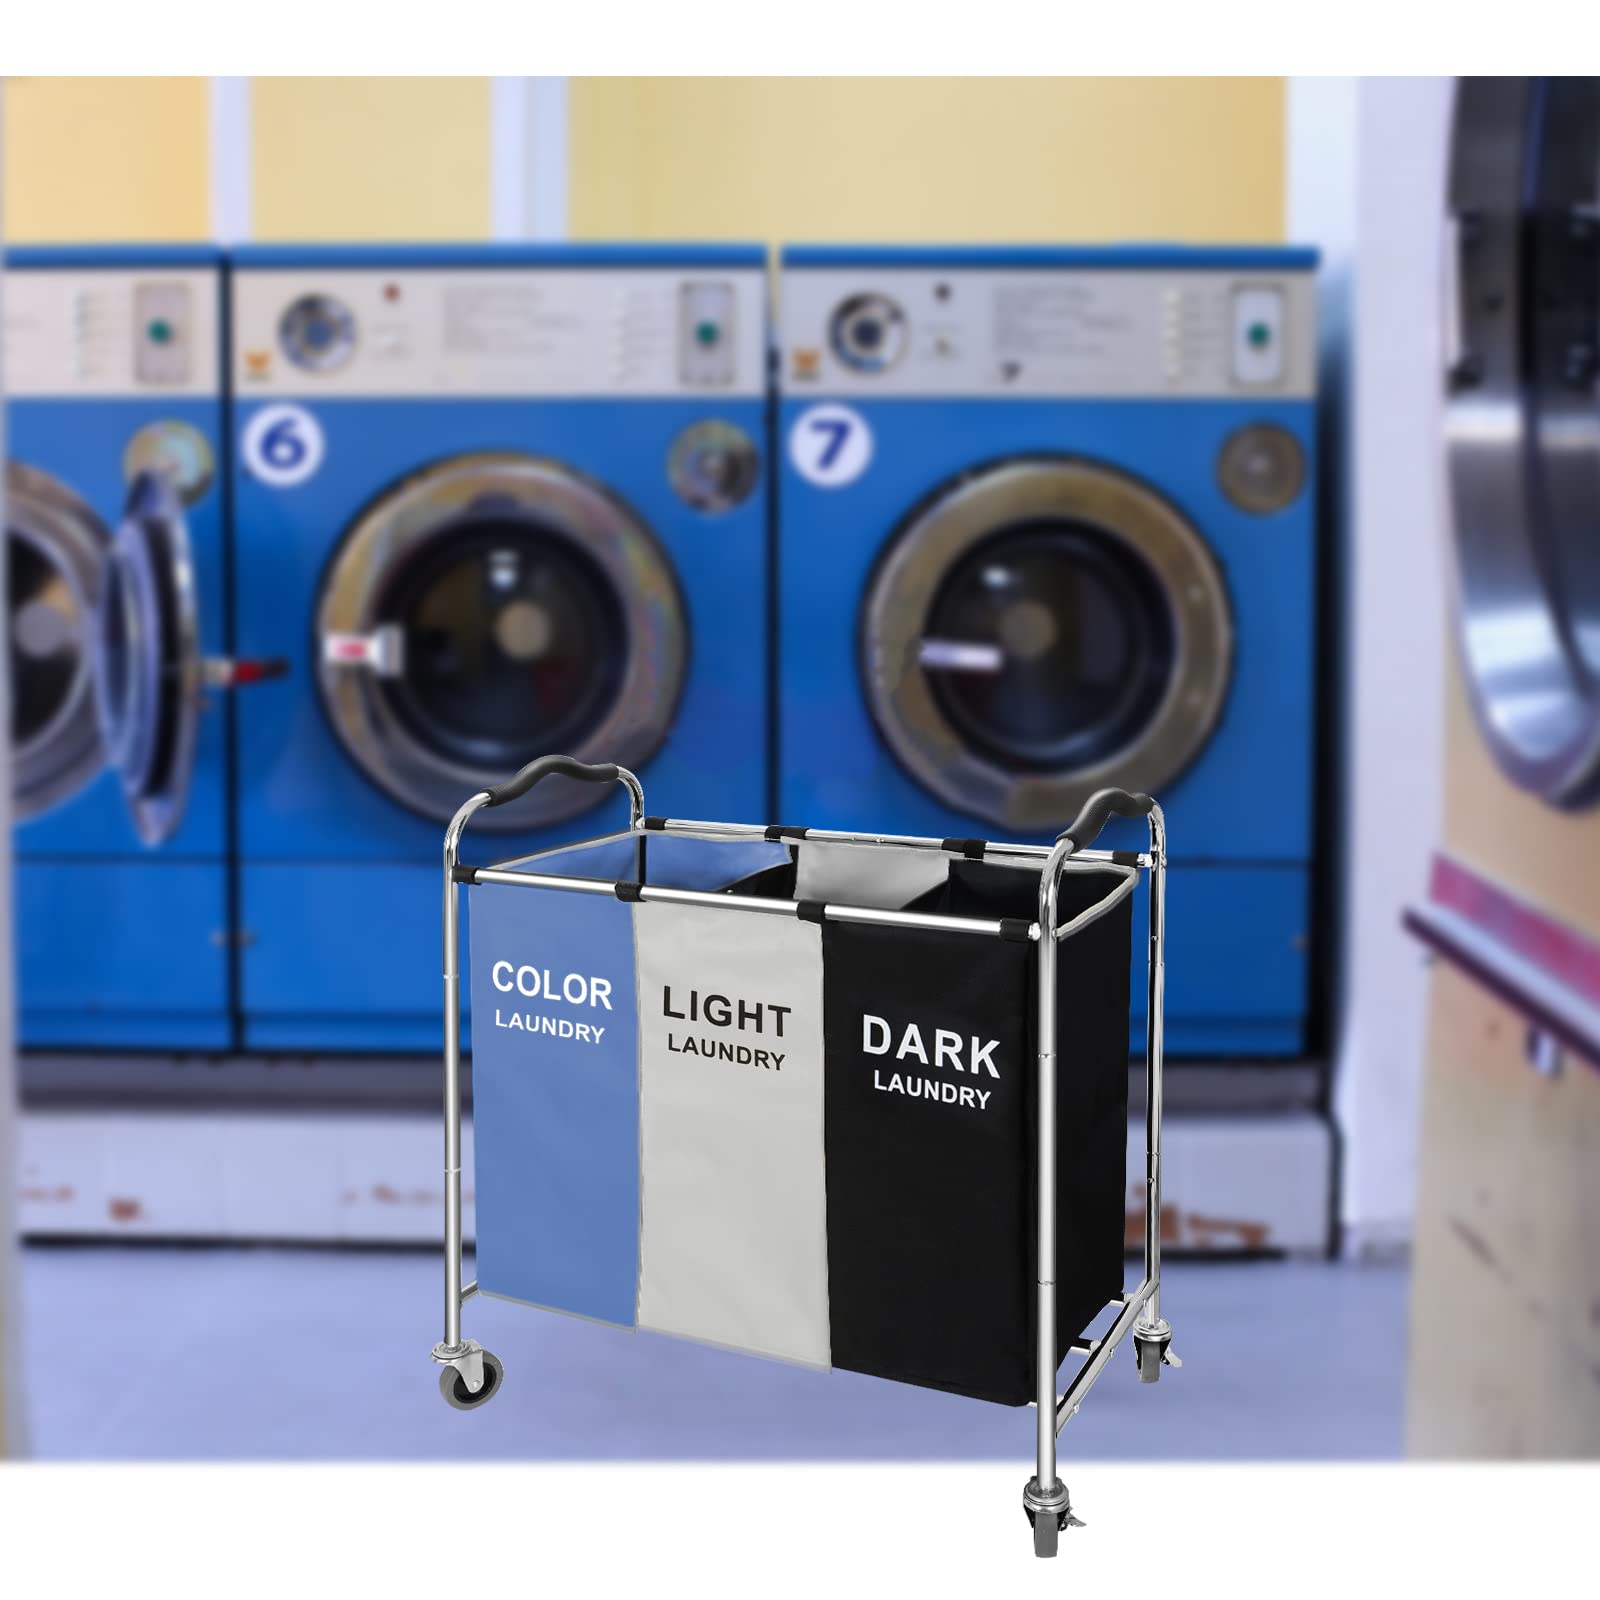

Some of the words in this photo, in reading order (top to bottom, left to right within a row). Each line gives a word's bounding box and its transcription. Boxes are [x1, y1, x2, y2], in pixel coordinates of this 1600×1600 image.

[260, 418, 306, 470] 6
[811, 419, 851, 470] 7
[492, 960, 613, 1011] COLOR
[495, 1009, 605, 1044] LAUNDRY
[663, 985, 792, 1038] LIGHT
[668, 1032, 786, 1071] LAUNDRY
[862, 1014, 1001, 1079] DARK
[874, 1069, 992, 1110] LAUNDRY
